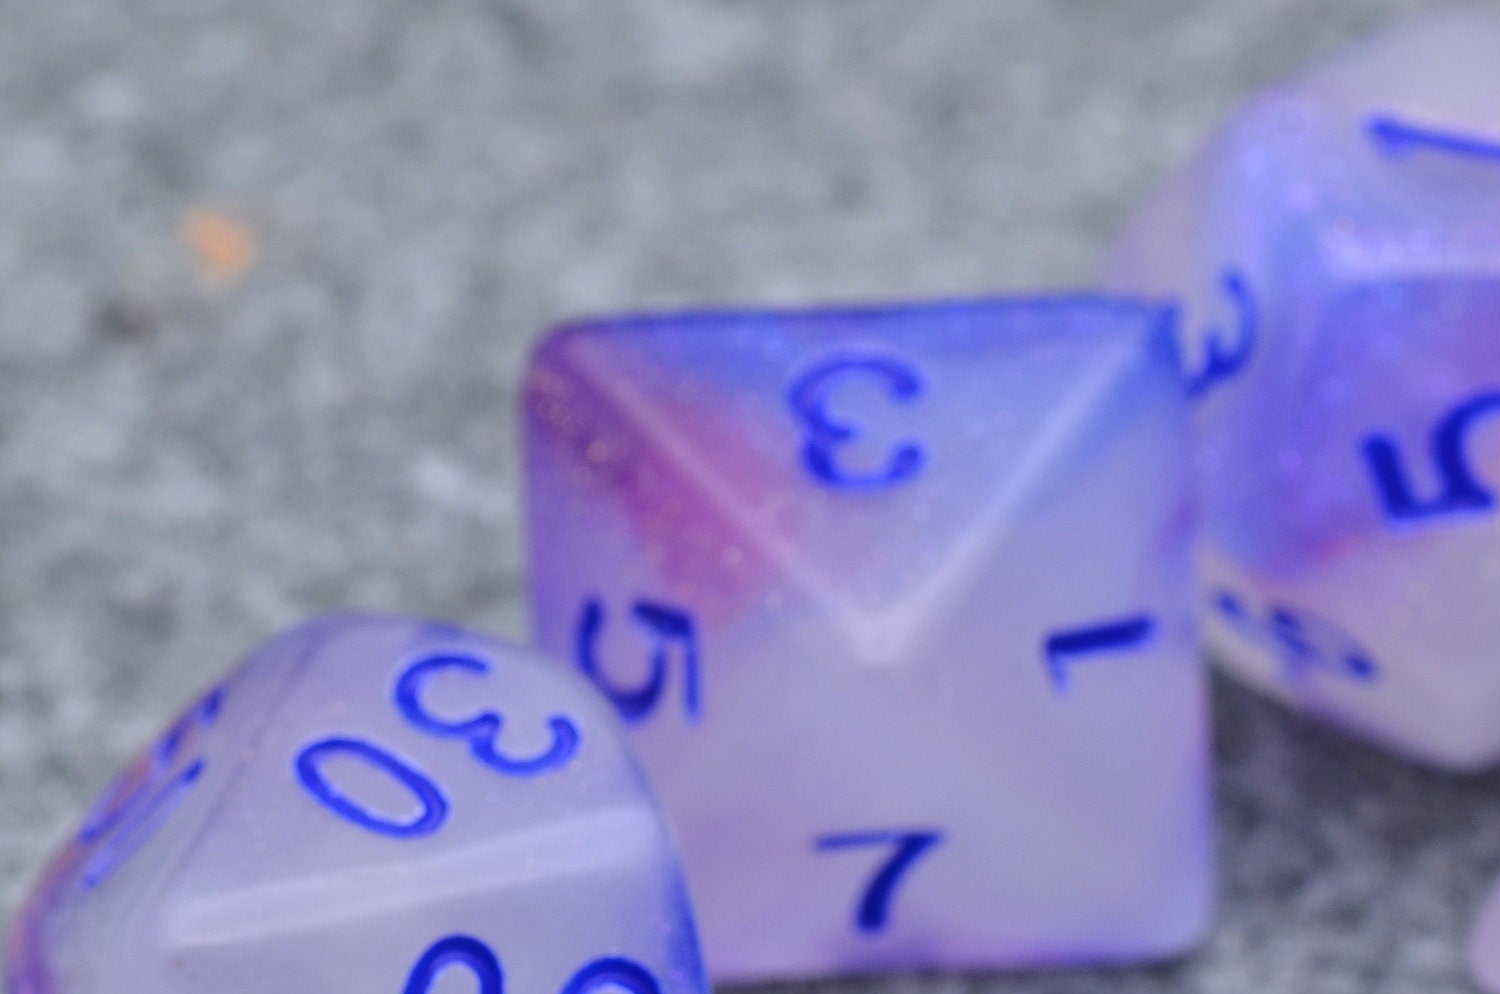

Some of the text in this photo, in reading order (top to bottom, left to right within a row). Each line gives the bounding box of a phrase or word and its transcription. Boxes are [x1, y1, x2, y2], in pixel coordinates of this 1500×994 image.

[790, 350, 926, 492] 3
[574, 596, 700, 724] 5
[1041, 611, 1158, 696] 1
[293, 651, 582, 840] 30
[812, 826, 944, 932] 7
